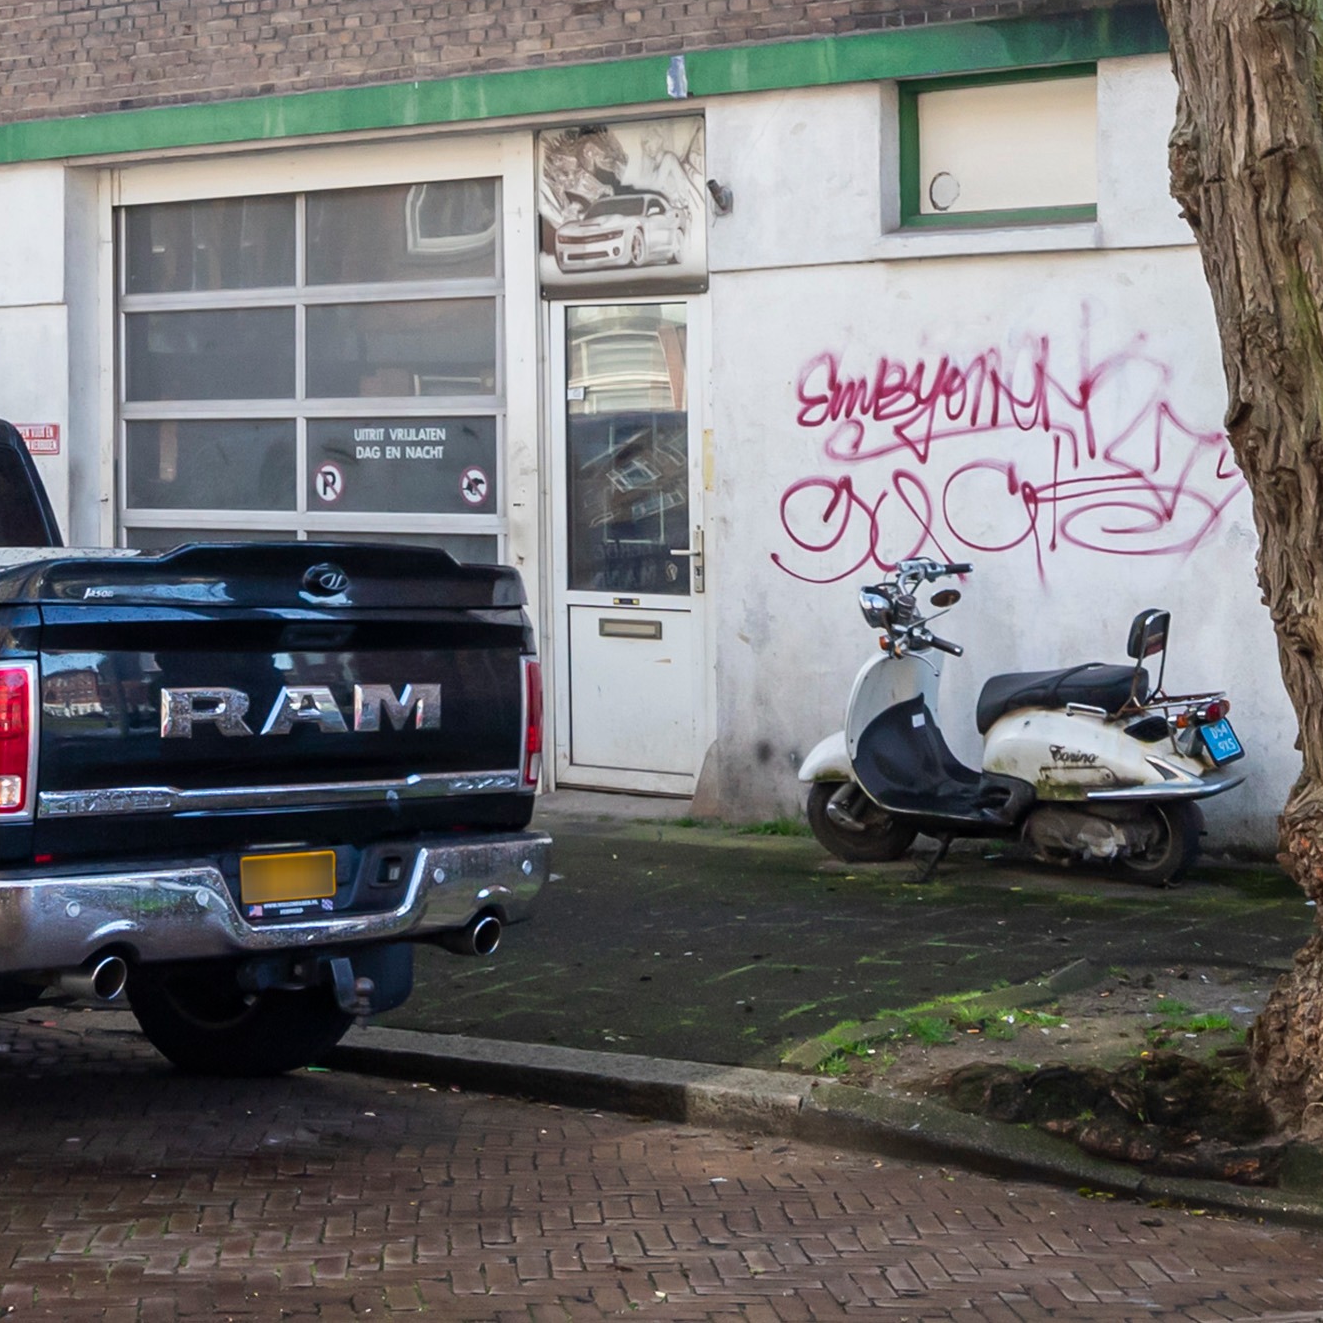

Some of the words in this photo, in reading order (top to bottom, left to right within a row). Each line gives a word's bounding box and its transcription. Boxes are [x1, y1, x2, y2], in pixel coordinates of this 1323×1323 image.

[353, 428, 385, 442] UITRIT
[389, 428, 446, 442] VRIJLATEN
[355, 446, 381, 459] DAG
[385, 446, 401, 459] EN
[405, 446, 444, 459] NACHT
[160, 683, 442, 739] RAM
[1048, 744, 1100, 766] Torino
